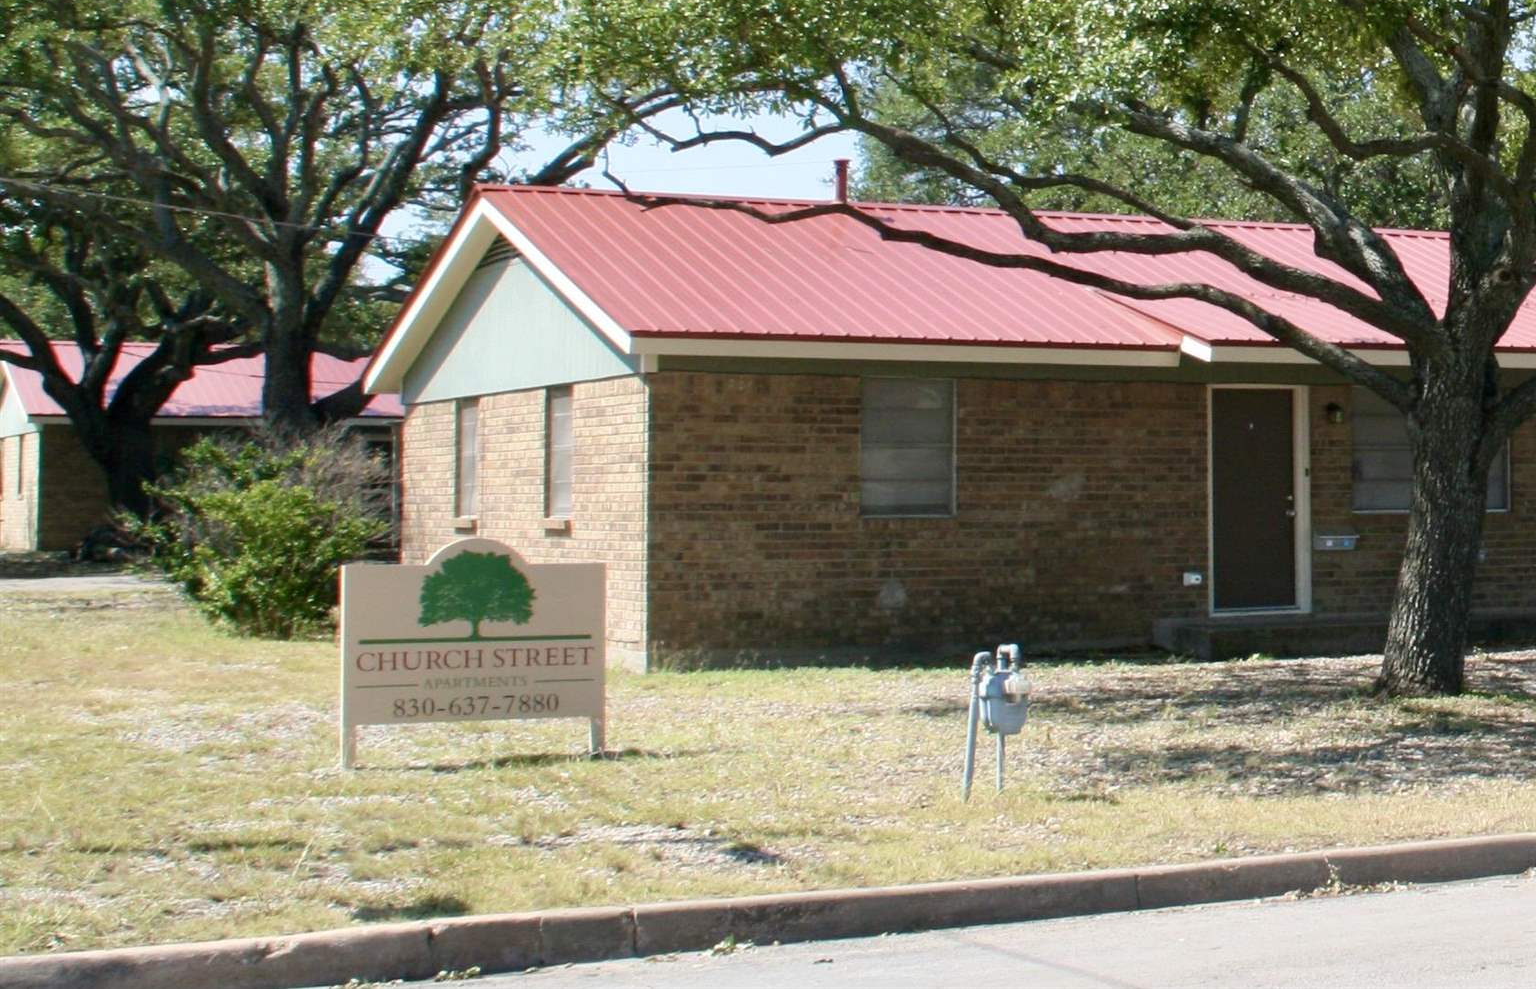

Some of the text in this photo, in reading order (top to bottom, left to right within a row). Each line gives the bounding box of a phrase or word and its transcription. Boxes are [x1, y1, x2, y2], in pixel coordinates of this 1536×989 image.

[356, 646, 595, 672] CHURCH STREET
[423, 676, 528, 691] APARTMENTS
[393, 693, 560, 718] 830-637-7880
